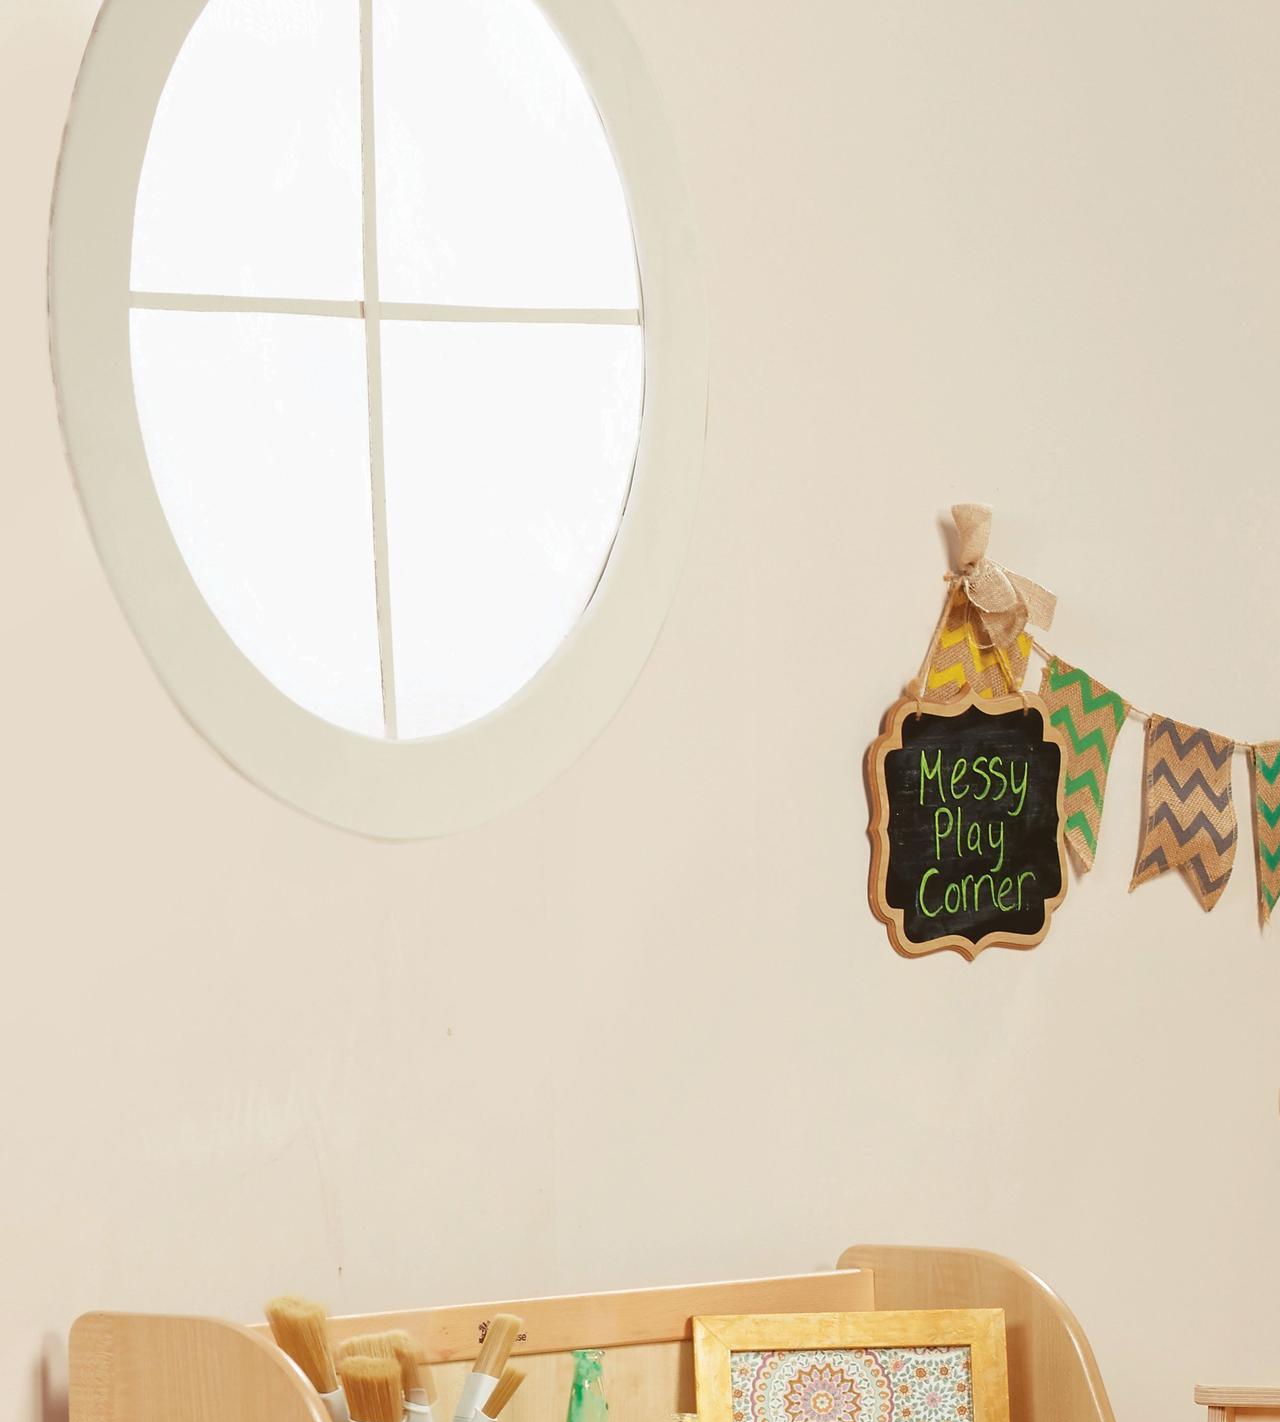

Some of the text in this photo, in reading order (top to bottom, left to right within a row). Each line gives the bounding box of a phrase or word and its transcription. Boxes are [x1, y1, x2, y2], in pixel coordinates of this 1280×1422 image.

[919, 749, 1028, 816] Messy
[934, 806, 1004, 872] Play
[918, 867, 1036, 918] Corner
